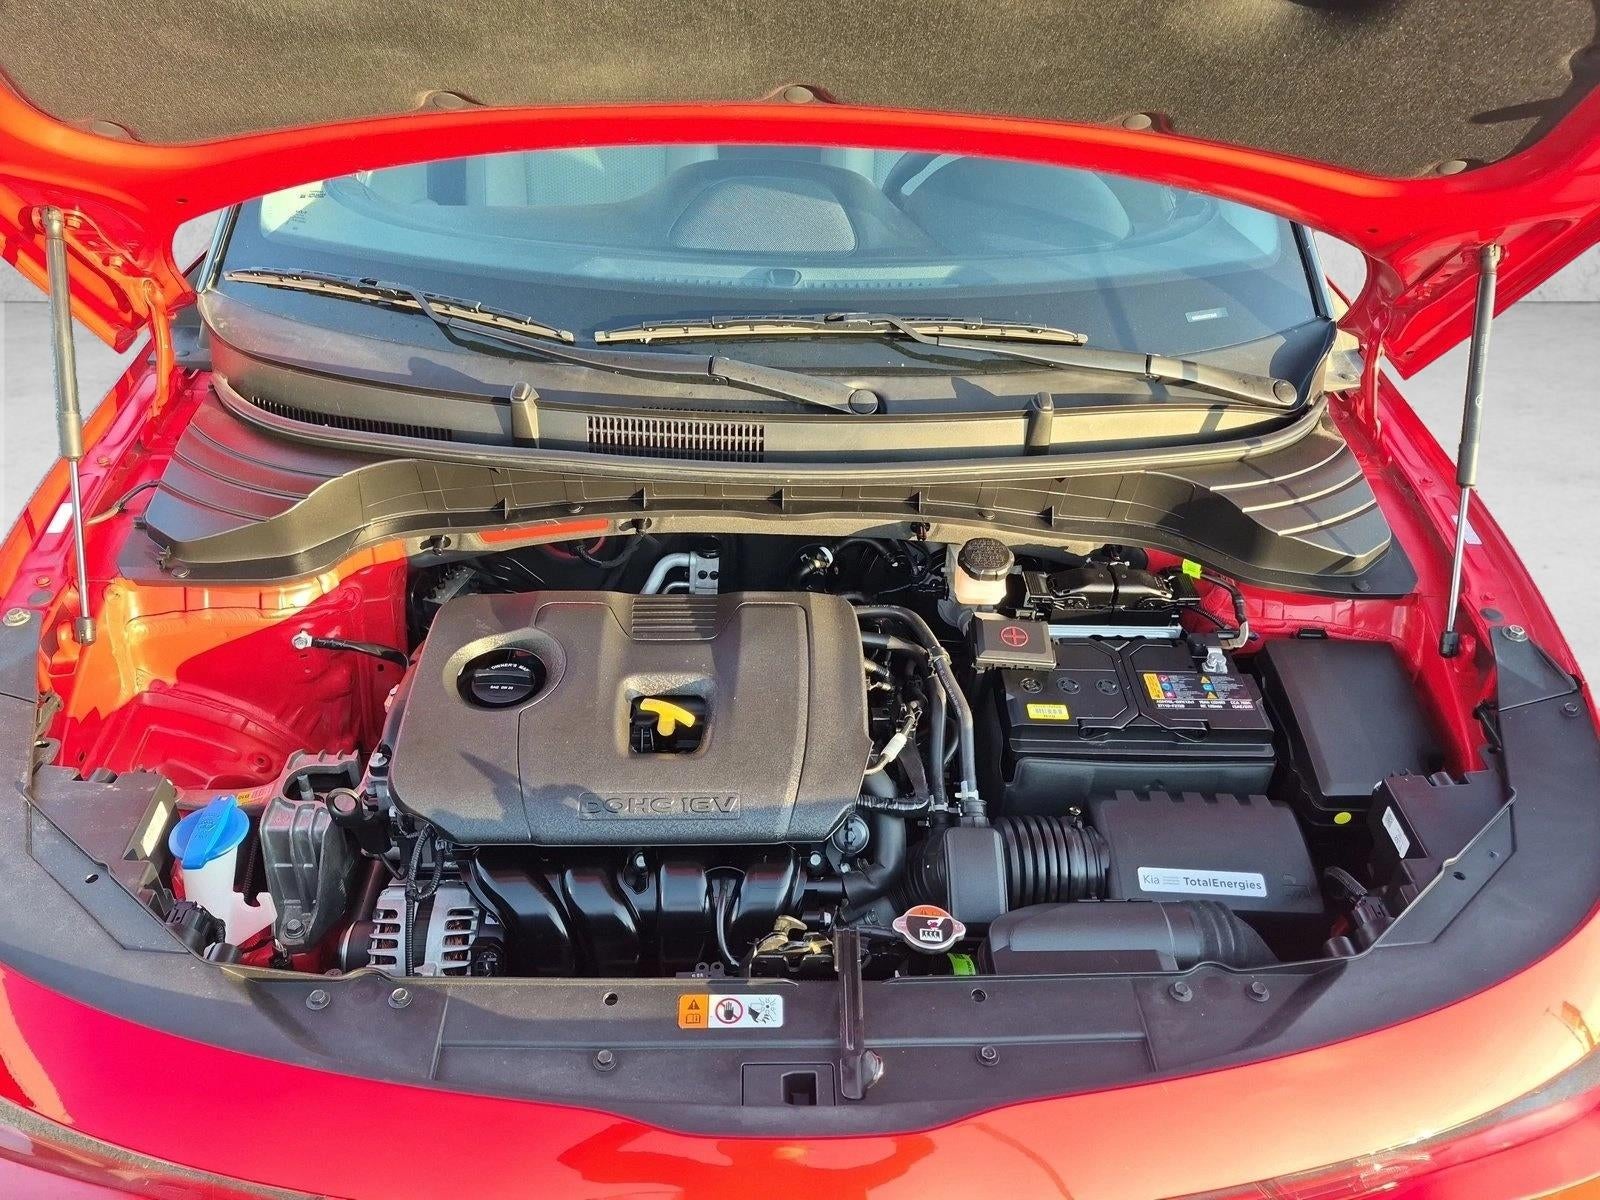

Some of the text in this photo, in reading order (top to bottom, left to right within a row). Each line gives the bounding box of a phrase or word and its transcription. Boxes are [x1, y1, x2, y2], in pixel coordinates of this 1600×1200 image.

[580, 796, 738, 814] DOHC 16V
[1143, 874, 1160, 885] Kia
[1183, 876, 1262, 891] TotalEnergies
